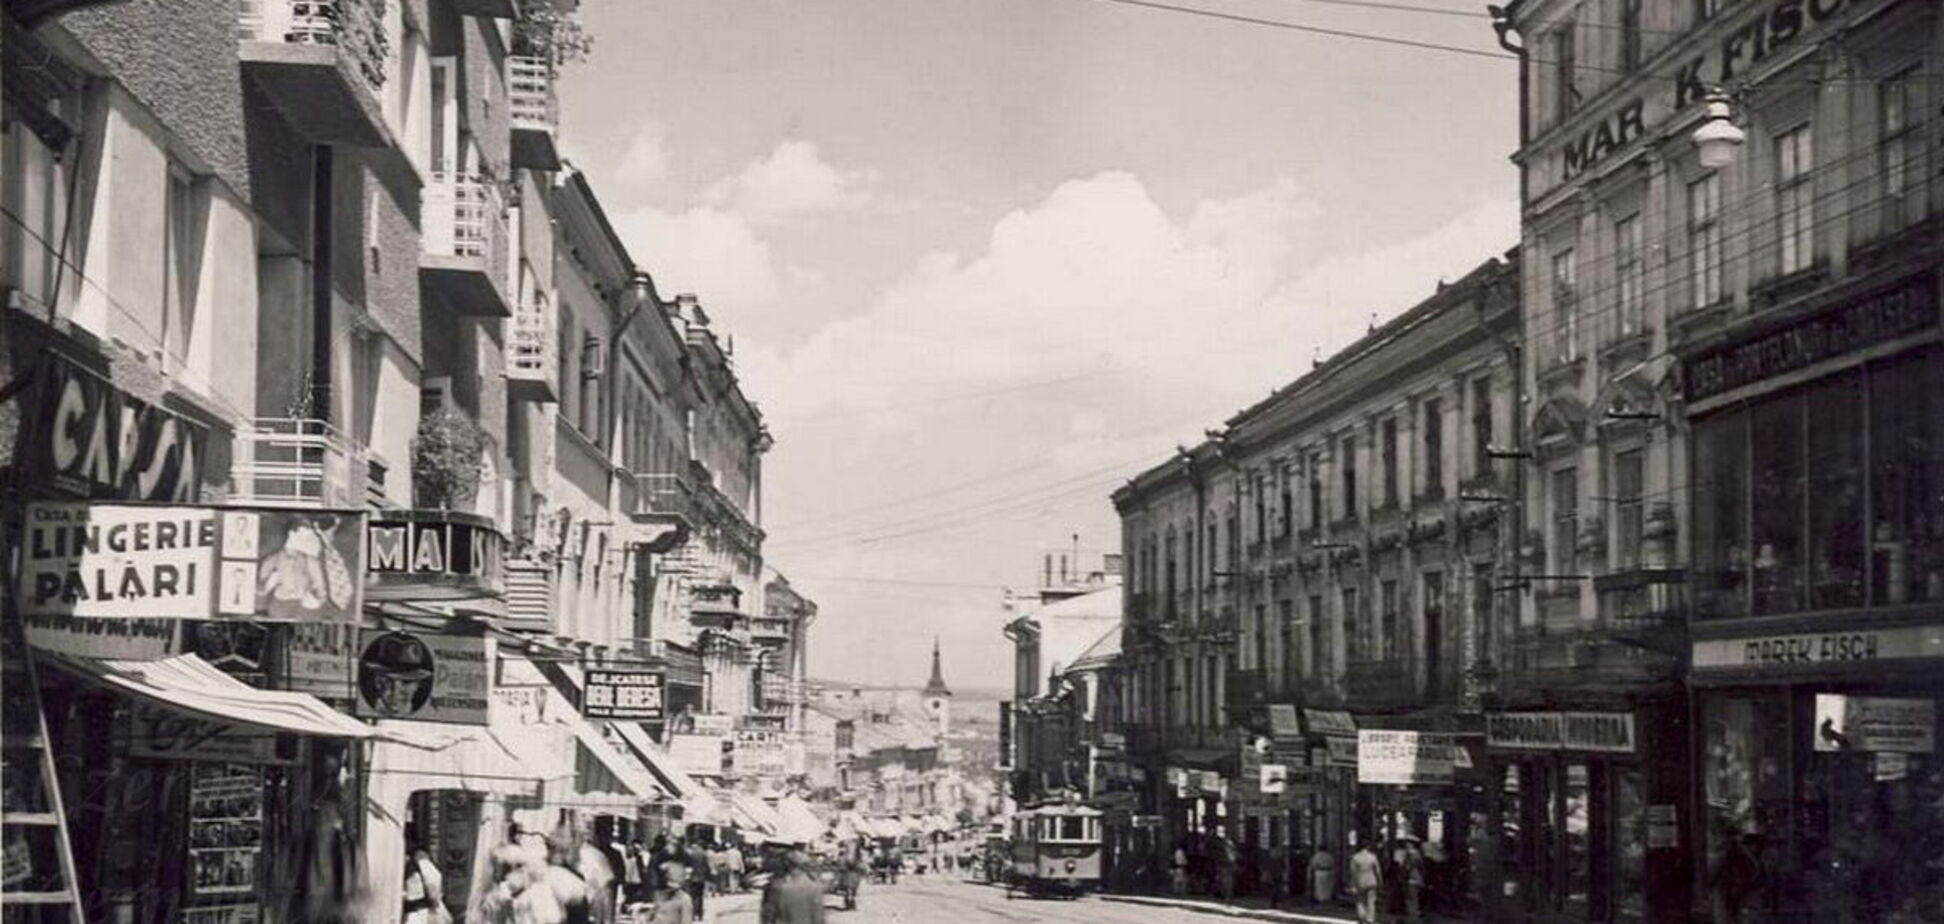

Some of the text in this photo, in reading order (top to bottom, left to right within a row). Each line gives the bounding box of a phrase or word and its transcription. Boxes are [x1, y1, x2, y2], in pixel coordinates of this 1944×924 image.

[52, 378, 195, 502] CAPSA
[33, 519, 215, 559] LINGERIE
[1746, 634, 1877, 664] MAREK FISCH
